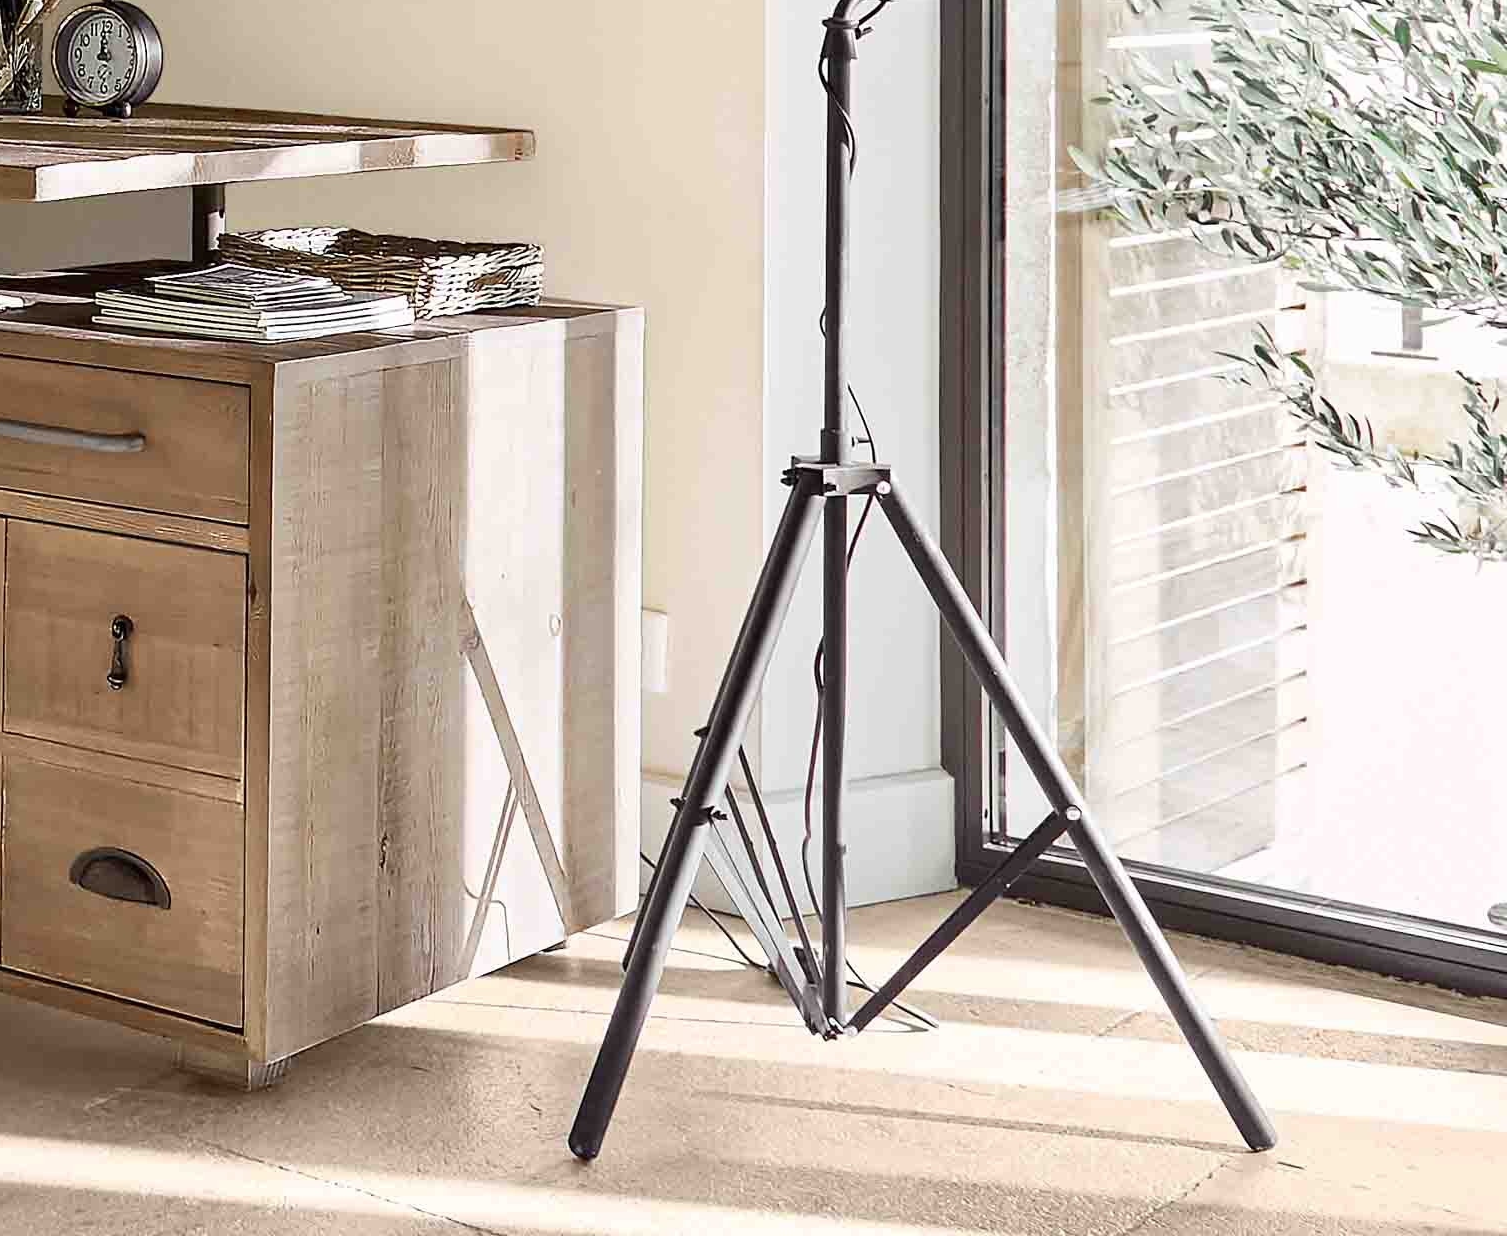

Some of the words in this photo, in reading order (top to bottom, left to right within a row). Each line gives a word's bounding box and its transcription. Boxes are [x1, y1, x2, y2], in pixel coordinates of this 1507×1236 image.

[90, 23, 99, 36] 11
[102, 20, 113, 34] 12
[79, 33, 90, 47] 10
[74, 47, 82, 63] 9
[77, 63, 86, 77] 8
[87, 76, 94, 89] 7
[100, 77, 108, 94] 6
[114, 78, 122, 92] 5
